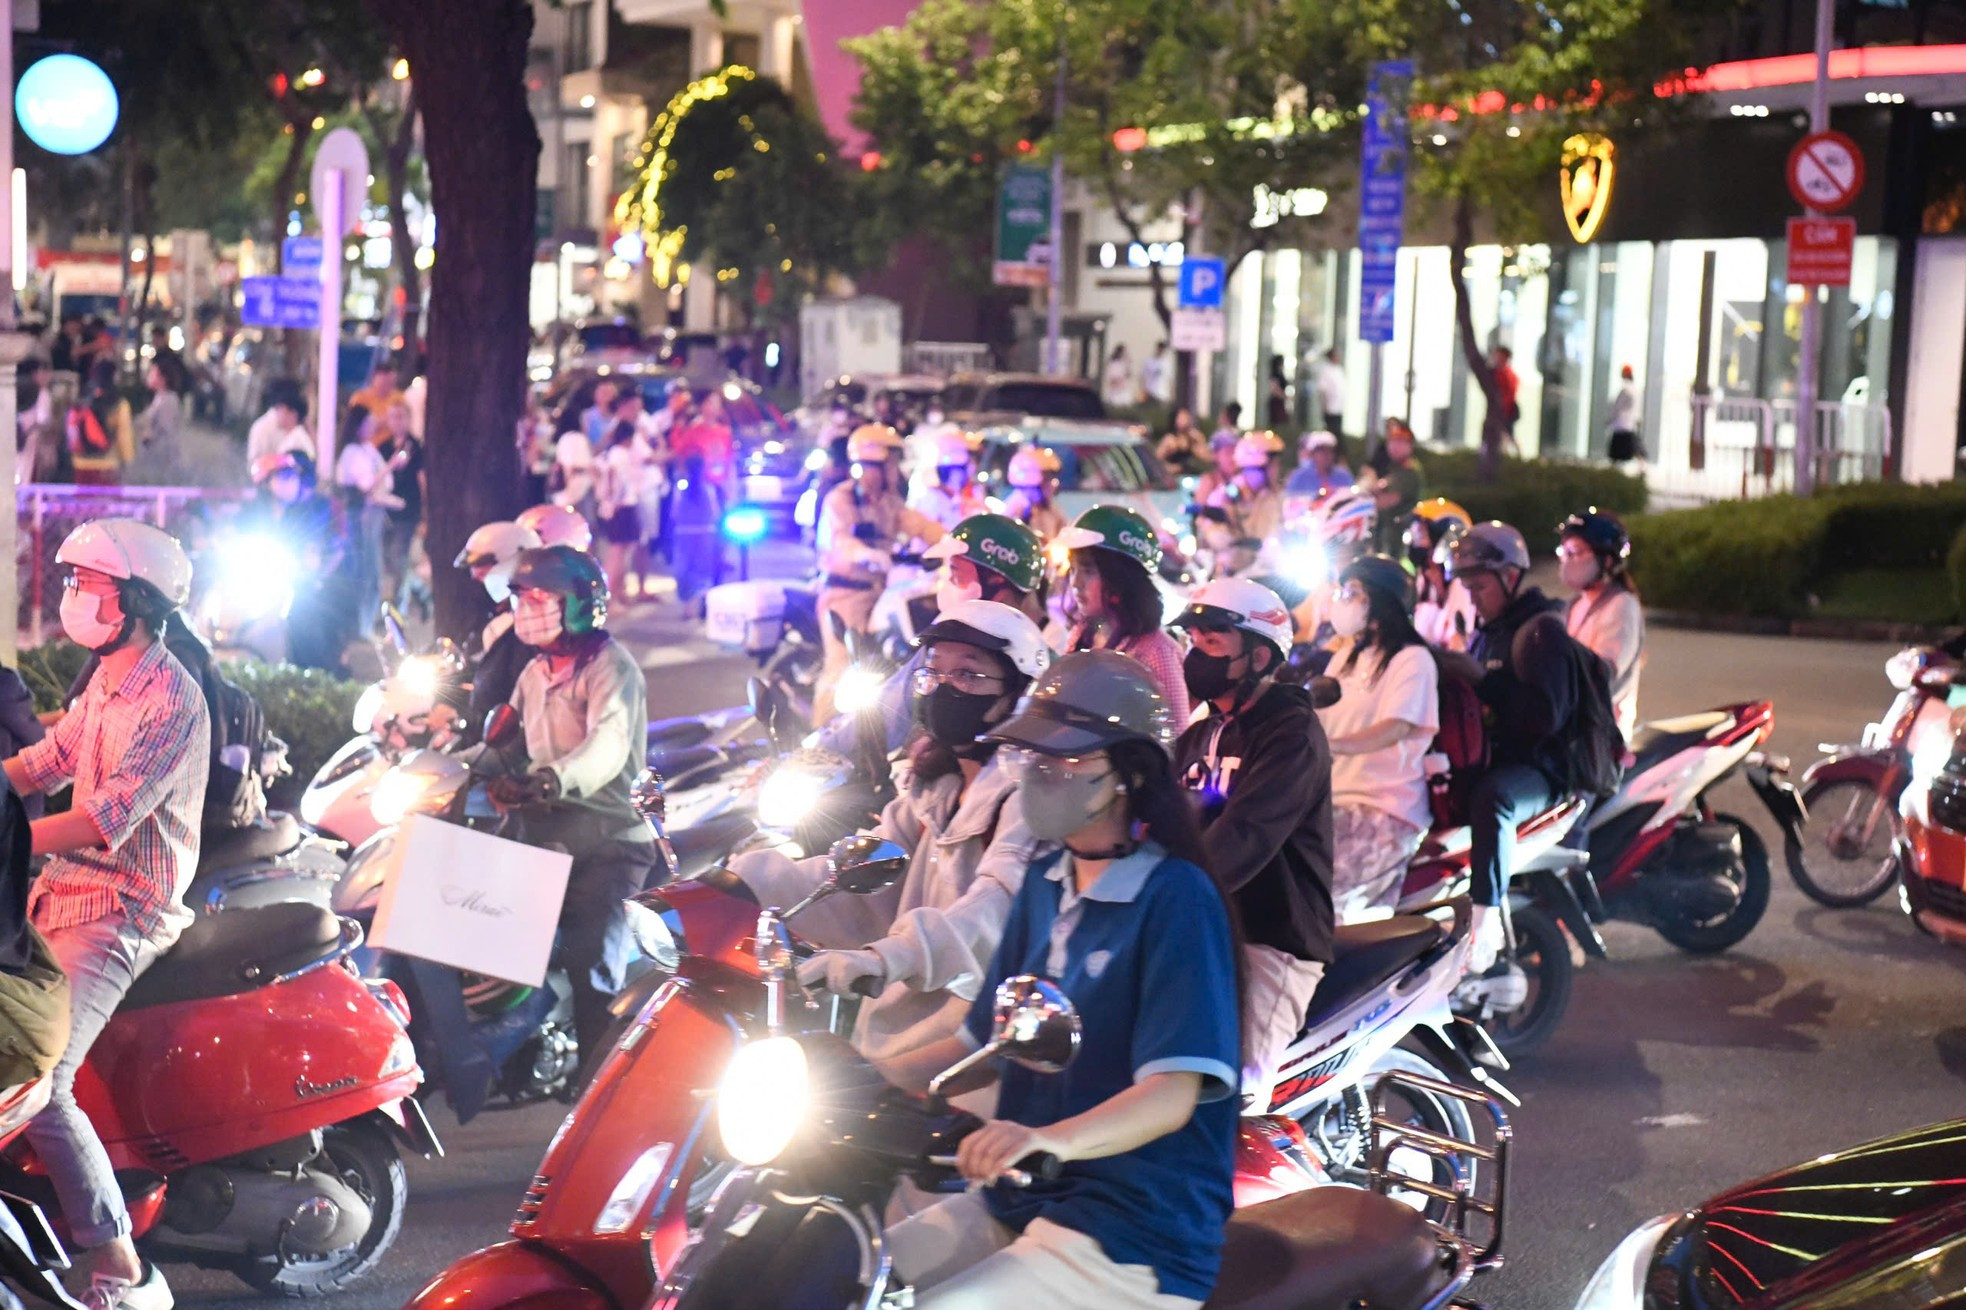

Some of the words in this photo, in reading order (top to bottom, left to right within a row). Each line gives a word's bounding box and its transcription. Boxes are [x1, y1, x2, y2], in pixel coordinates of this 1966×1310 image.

[1192, 267, 1217, 298] P
[980, 538, 1019, 565] Grab
[1119, 530, 1153, 558] Grab
